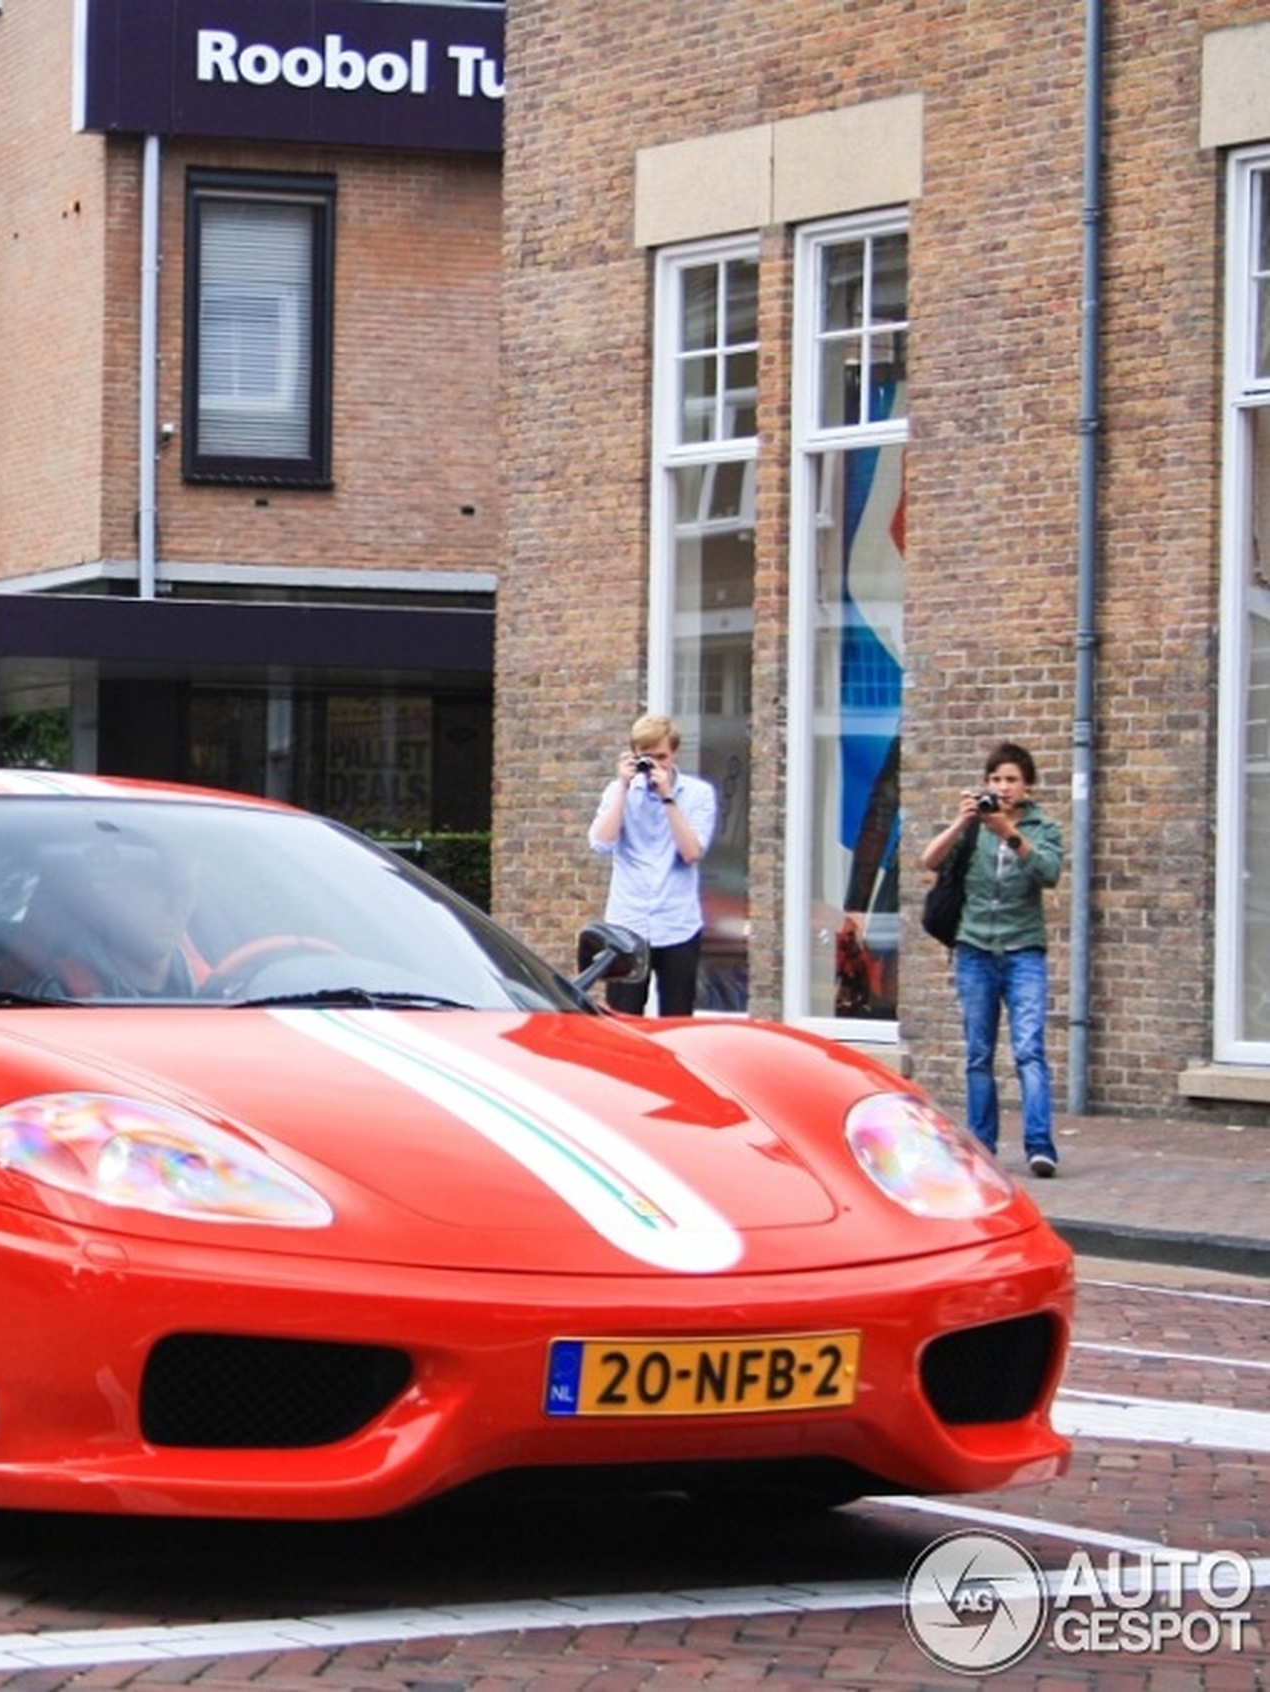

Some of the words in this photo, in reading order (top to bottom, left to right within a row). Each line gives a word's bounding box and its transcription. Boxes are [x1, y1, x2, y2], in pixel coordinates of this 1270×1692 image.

[197, 29, 428, 94] Roobol
[330, 738, 428, 770] PALLET
[330, 773, 428, 805] DEALS
[550, 1385, 574, 1403] NL
[596, 1344, 842, 1404] 20-NFB-2
